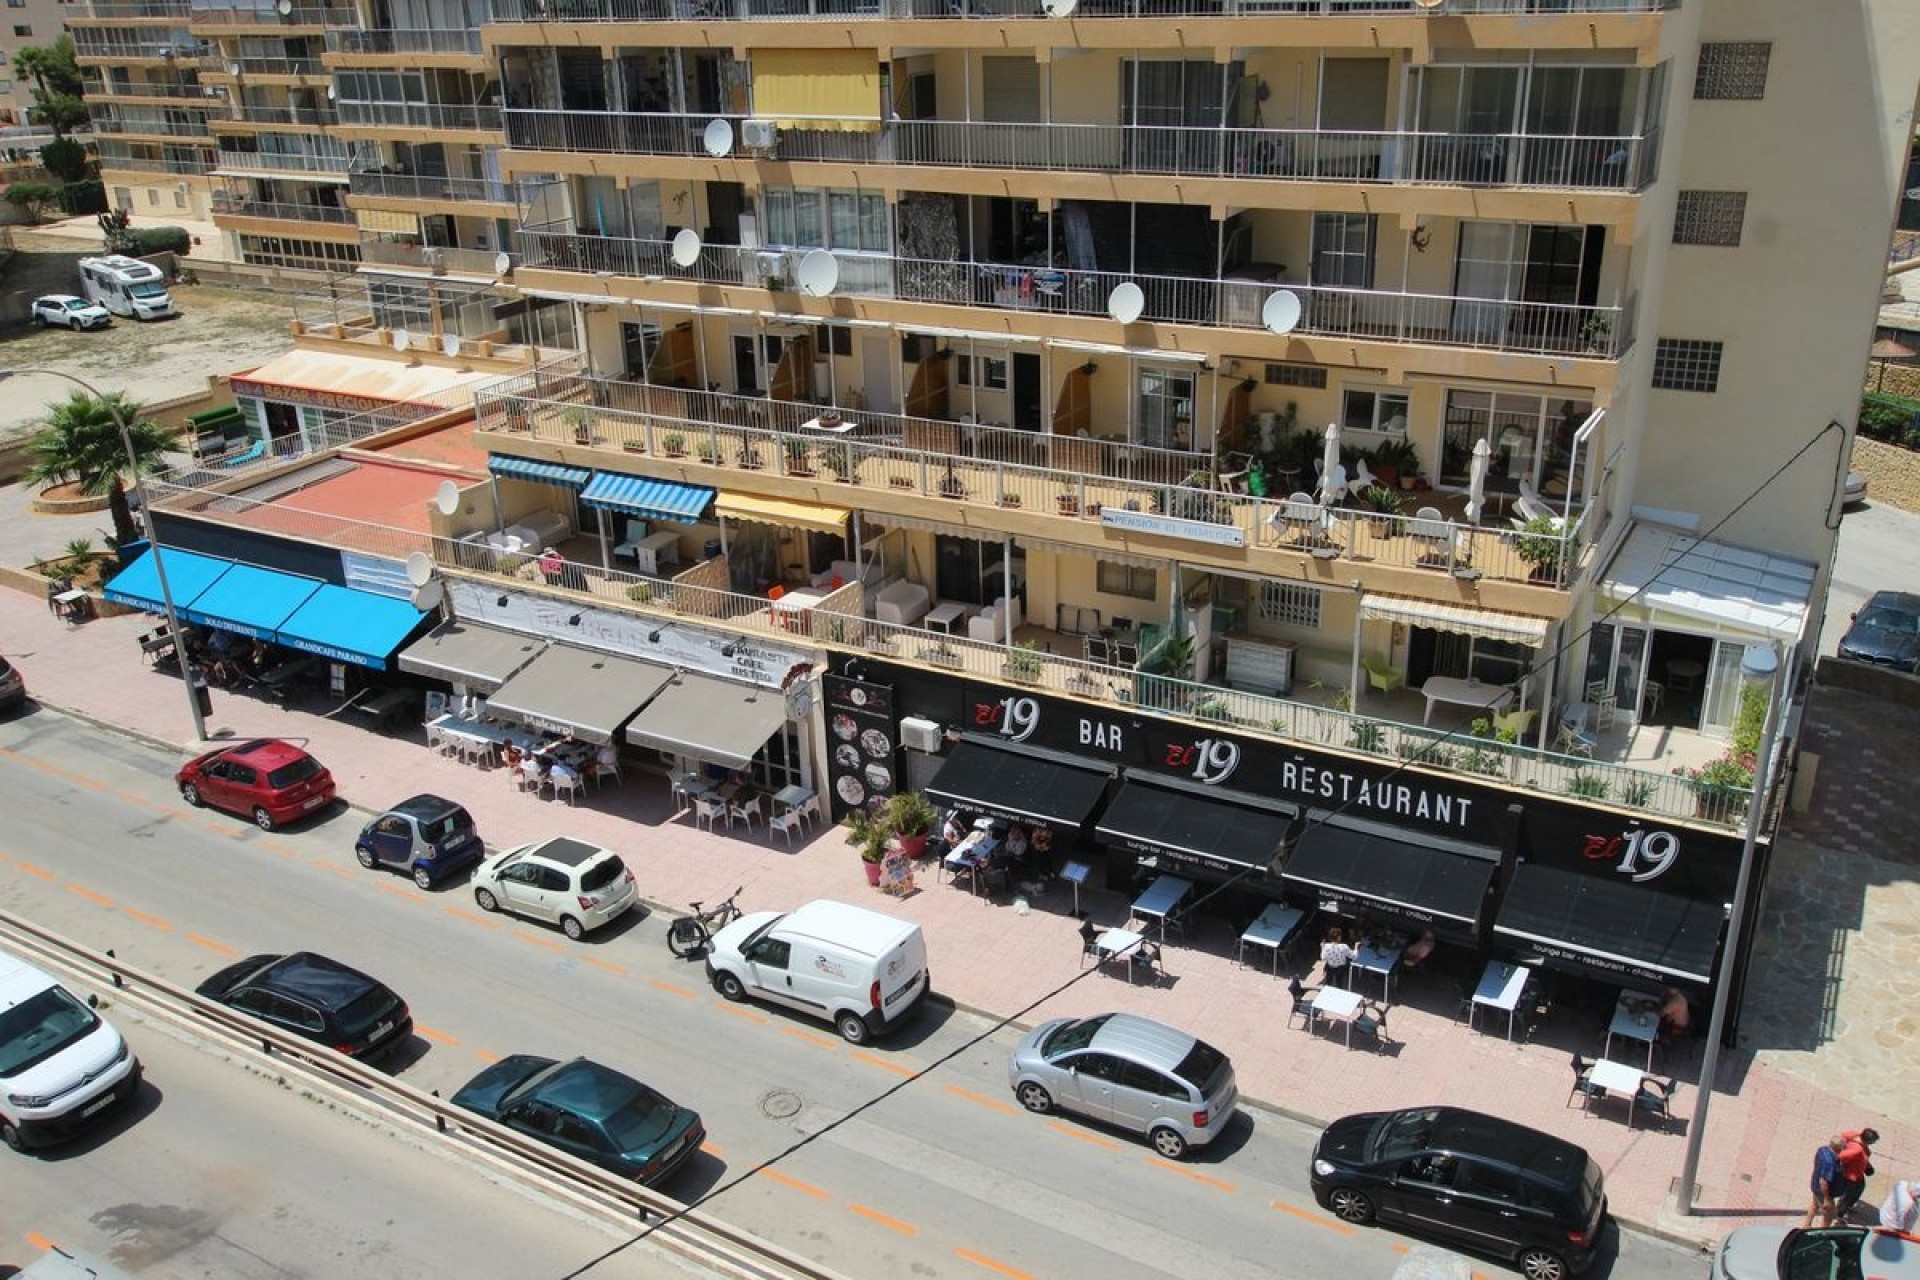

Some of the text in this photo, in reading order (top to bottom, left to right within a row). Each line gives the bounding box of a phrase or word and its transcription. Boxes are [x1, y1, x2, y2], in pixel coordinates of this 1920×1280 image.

[975, 697, 1040, 743] El 19
[1079, 718, 1123, 752] BAR
[1166, 737, 1241, 785] El 19
[1282, 761, 1472, 827] RESTAURANT
[1584, 830, 1680, 882] El 19
